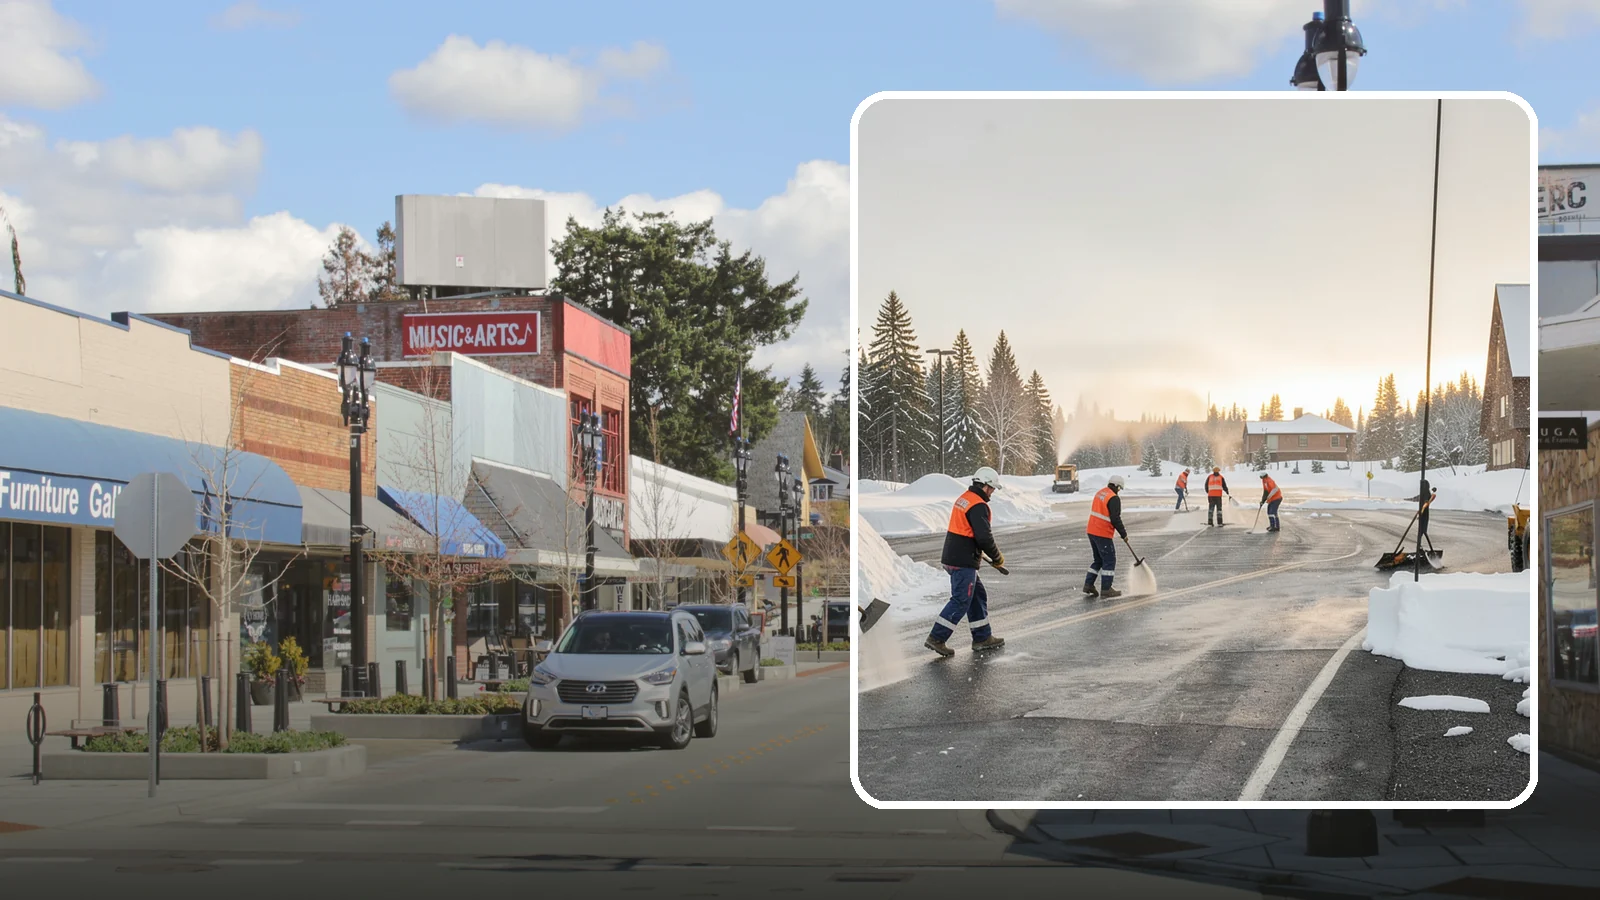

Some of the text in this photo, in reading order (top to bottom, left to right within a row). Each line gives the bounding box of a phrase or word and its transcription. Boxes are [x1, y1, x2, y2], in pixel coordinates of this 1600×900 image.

[409, 323, 519, 349] MUSIC&ARTS
[1540, 427, 1577, 437] UGA
[0, 471, 122, 519] Furniture Gal
[453, 562, 479, 574] SUSHI
